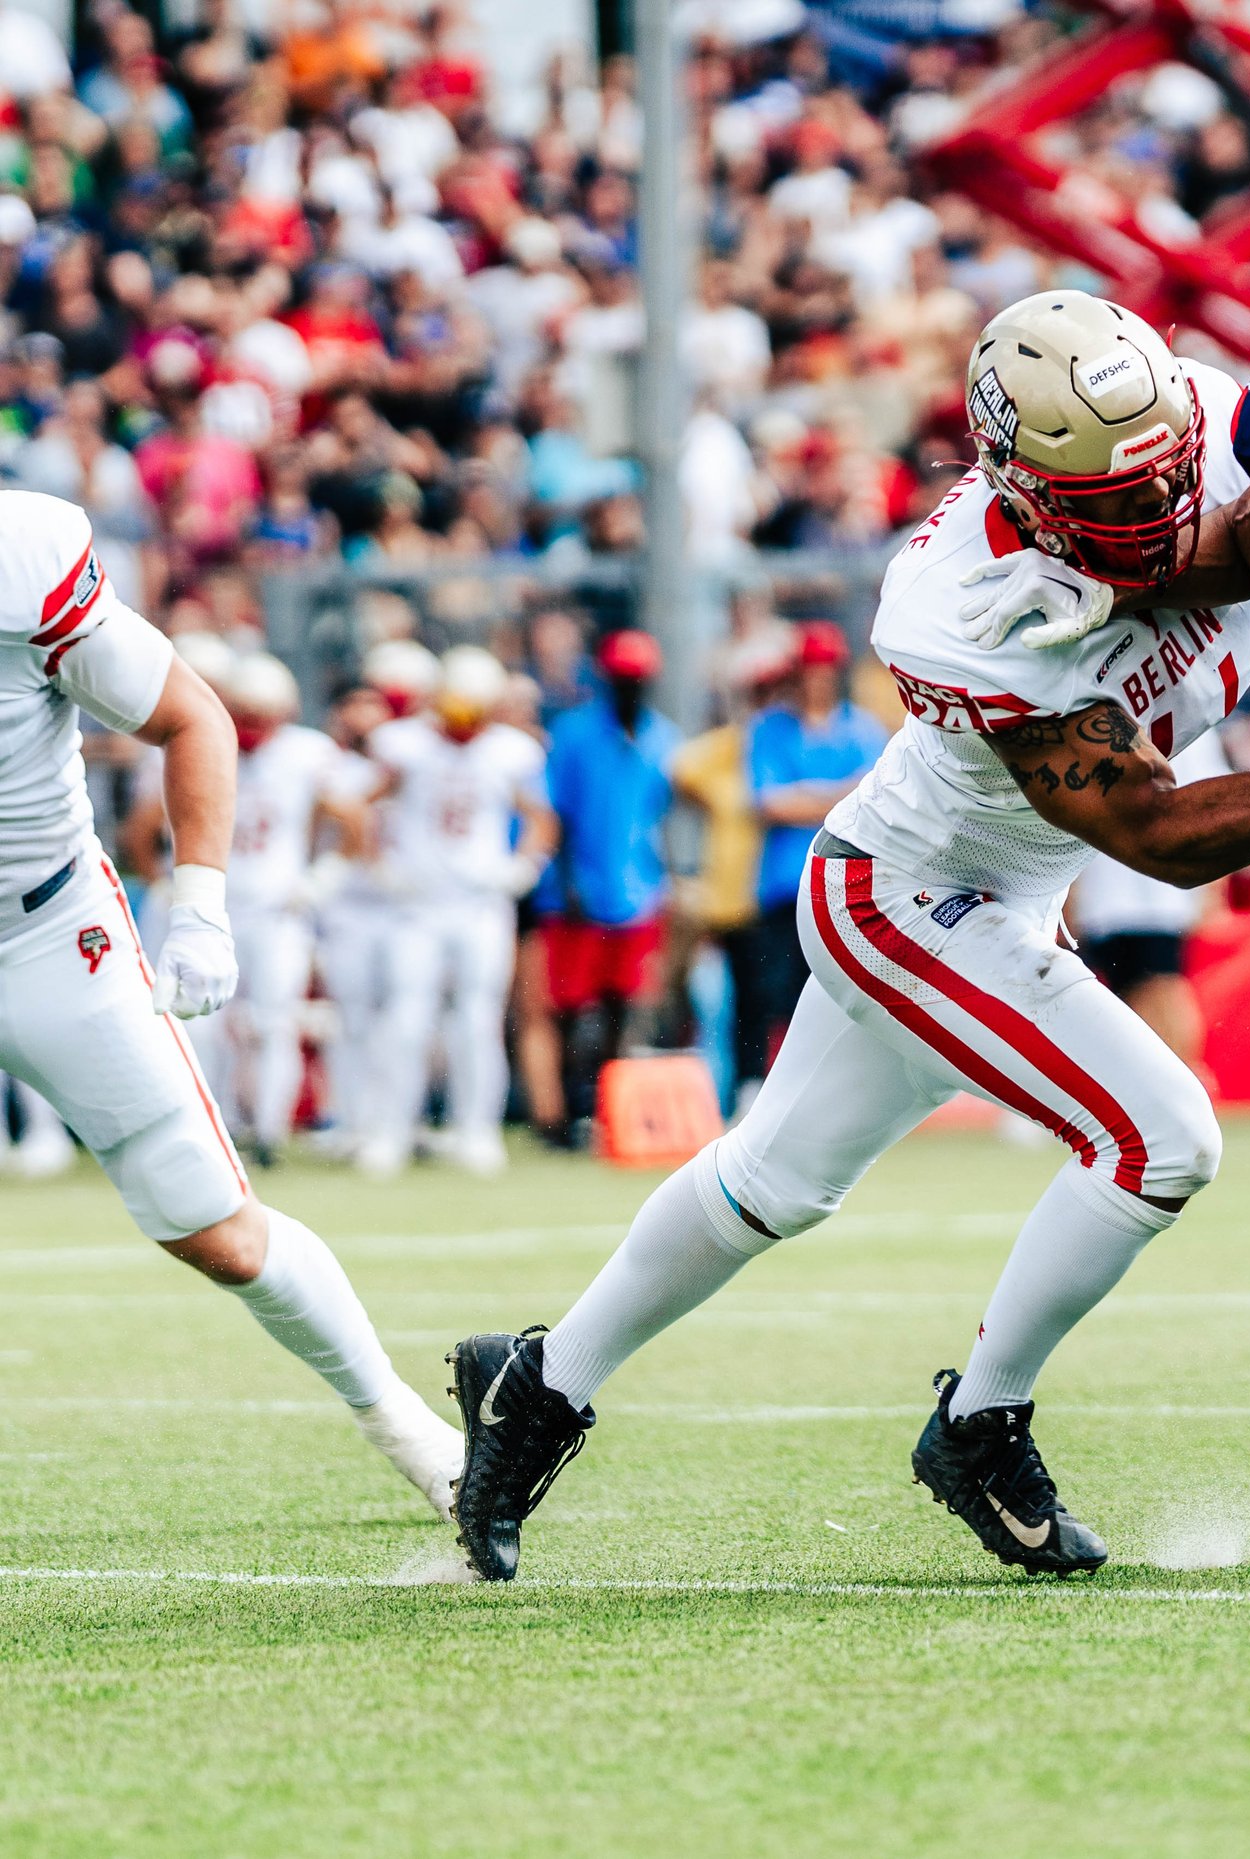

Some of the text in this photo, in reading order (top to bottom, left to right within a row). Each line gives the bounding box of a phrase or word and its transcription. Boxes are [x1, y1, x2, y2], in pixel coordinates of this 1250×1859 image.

[1122, 607, 1223, 718] BERLIN
[934, 897, 961, 919] EUROPEAN
[939, 904, 960, 923] LEAGUE
[944, 903, 972, 927] FOOTBALL
